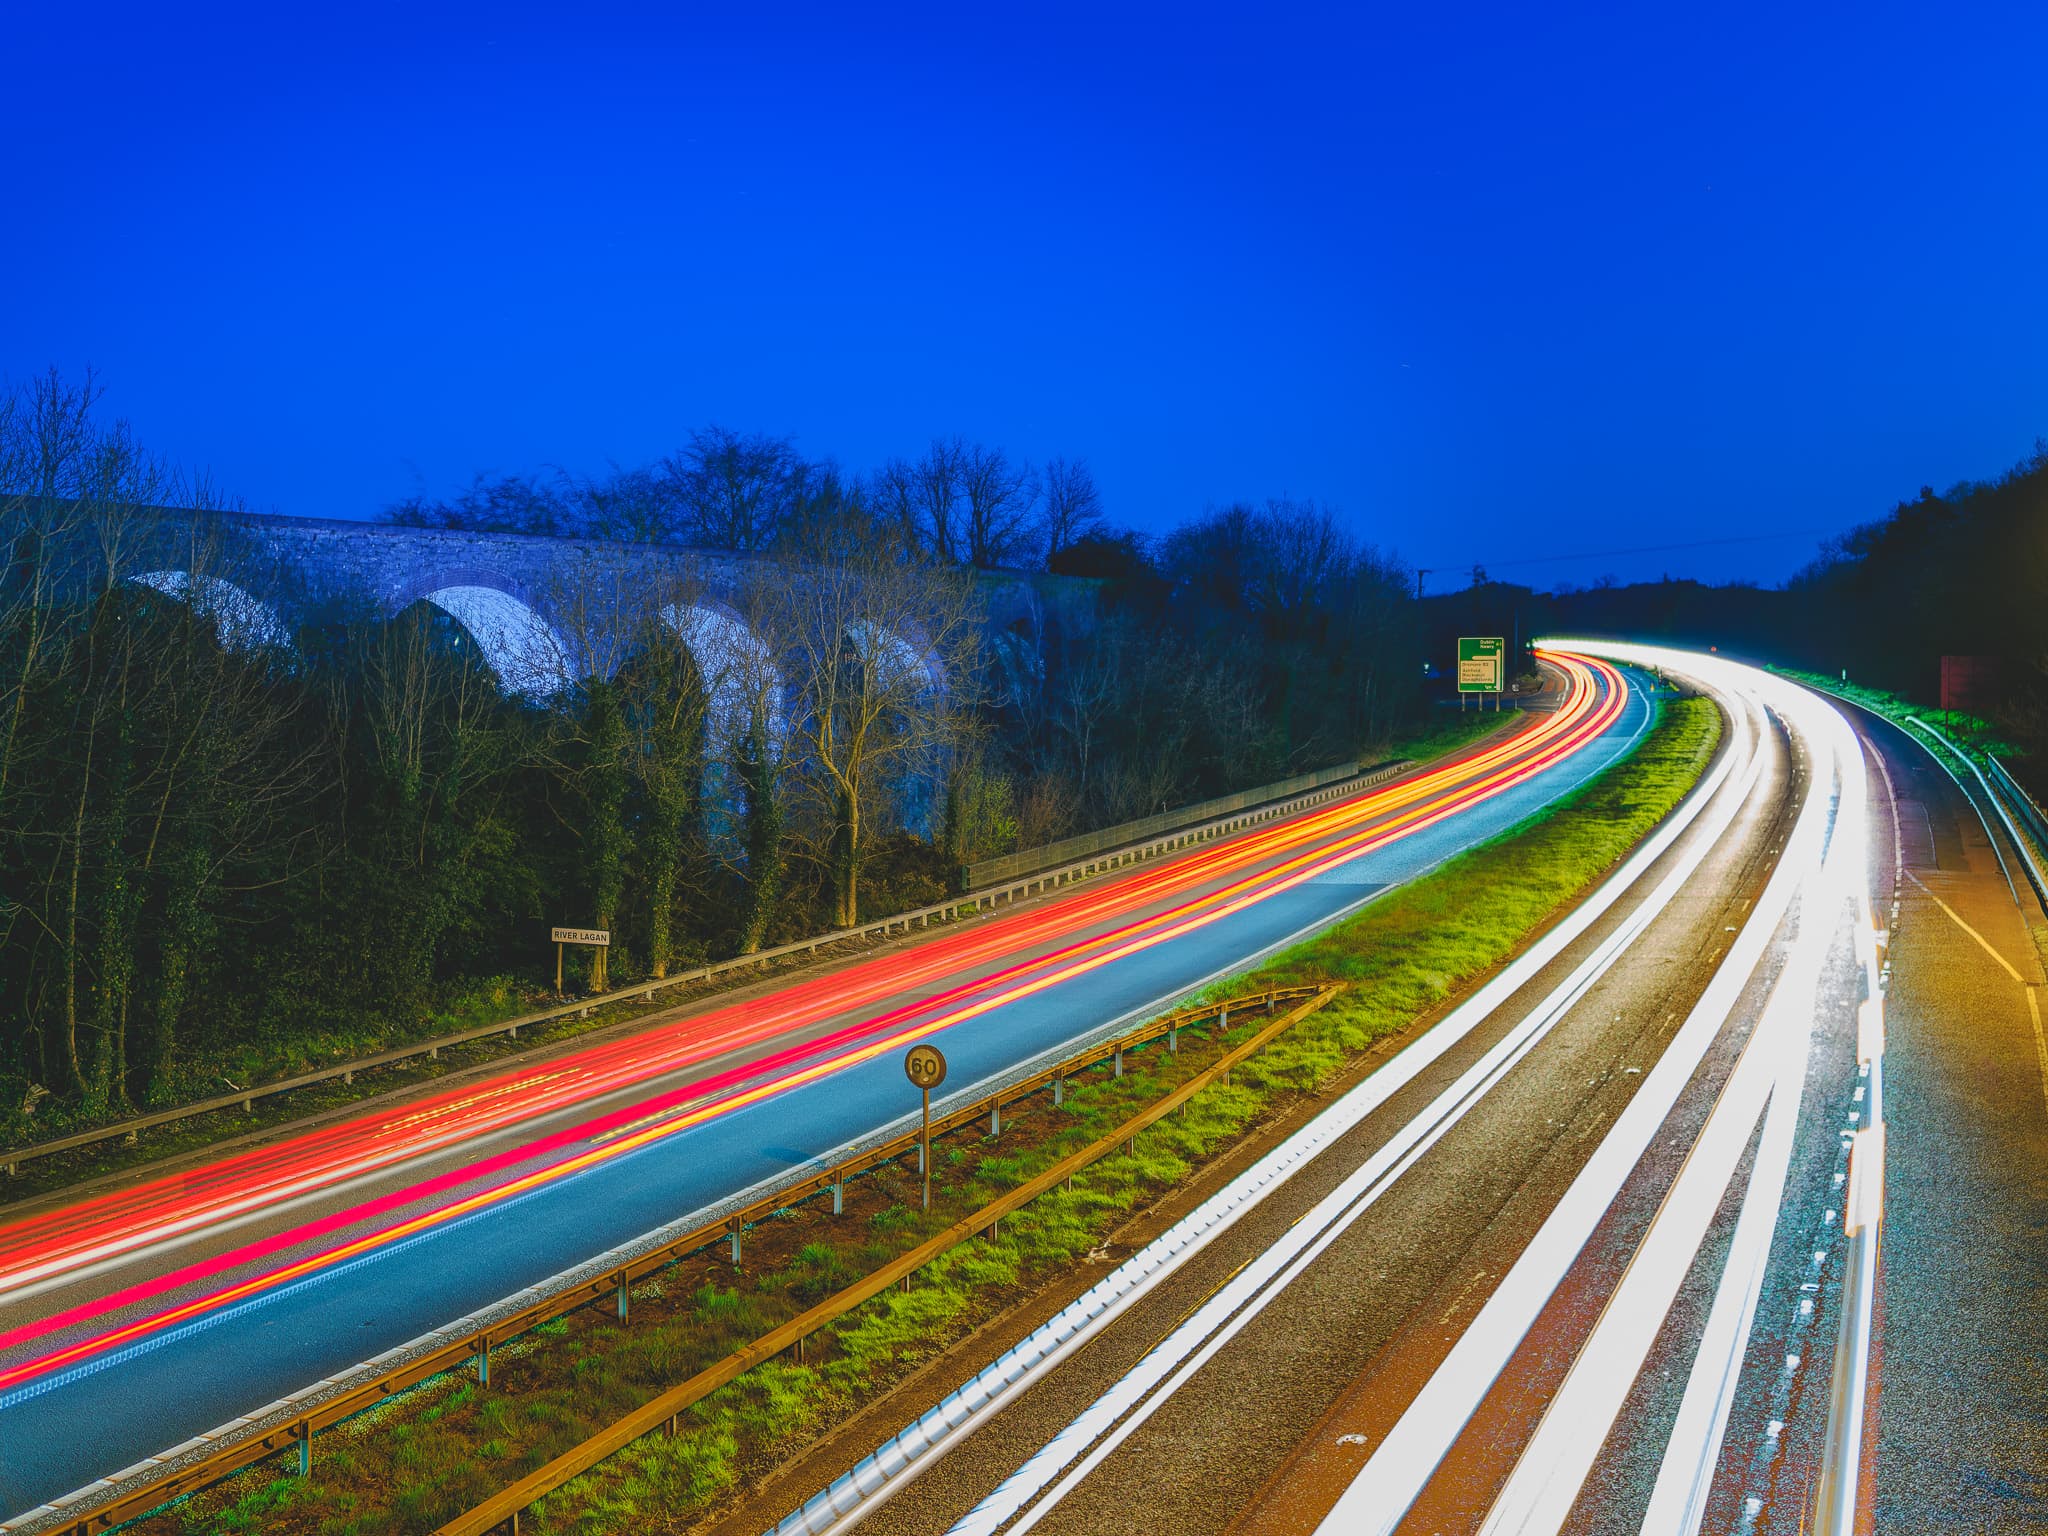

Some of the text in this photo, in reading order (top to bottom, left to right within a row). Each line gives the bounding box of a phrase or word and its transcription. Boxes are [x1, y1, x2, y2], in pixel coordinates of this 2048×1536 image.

[555, 931, 607, 941] RIVER LAGAN
[912, 1058, 936, 1076] 60
